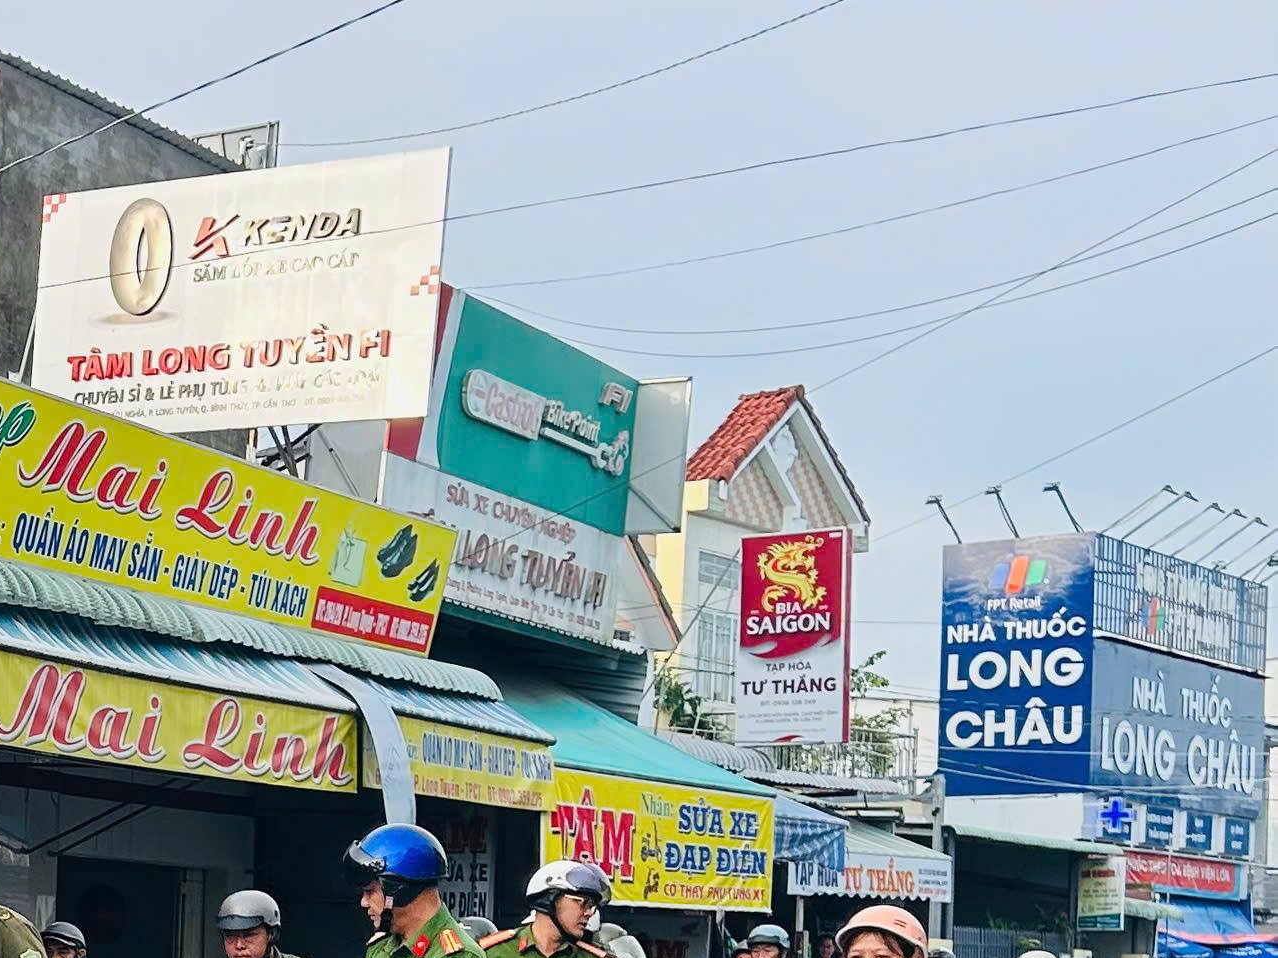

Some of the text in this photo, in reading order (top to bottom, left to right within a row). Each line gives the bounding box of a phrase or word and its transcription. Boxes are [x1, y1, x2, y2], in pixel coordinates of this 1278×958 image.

[244, 208, 362, 247] KENDA
[67, 347, 133, 383] TÂM
[141, 342, 231, 376] LONG
[144, 386, 155, 401] &
[178, 383, 206, 402] PHỤ
[155, 408, 174, 416] LONG
[18, 420, 167, 522] Mai
[175, 468, 320, 566] Linh
[472, 493, 490, 515] XE
[13, 508, 64, 559] QUẦN
[63, 519, 90, 565] ÁO
[89, 532, 129, 575] MAY
[172, 551, 208, 594] GIÀY
[208, 559, 239, 600] DÉP
[248, 569, 273, 610] TÚI
[271, 577, 310, 619] XÁCH
[746, 611, 832, 636] SAIGON
[775, 602, 802, 615] BIA
[946, 606, 1087, 644] NHÀ THUỐC
[741, 673, 837, 696] TƯ THẮNG
[946, 647, 1085, 691] LONG
[1132, 670, 1232, 729] NHÀ THUỐC
[945, 696, 1084, 748] CHÂU
[182, 698, 354, 787] Linh
[1100, 716, 1257, 794] LONG CHÂU
[551, 786, 636, 884] TÂM
[678, 797, 724, 838] SỬA
[729, 811, 760, 840] XE
[445, 860, 488, 882] ỬA XE
[664, 842, 767, 884] ĐẠP ĐIỆN
[794, 861, 813, 891] TẠP
[844, 864, 863, 892] TƯ
